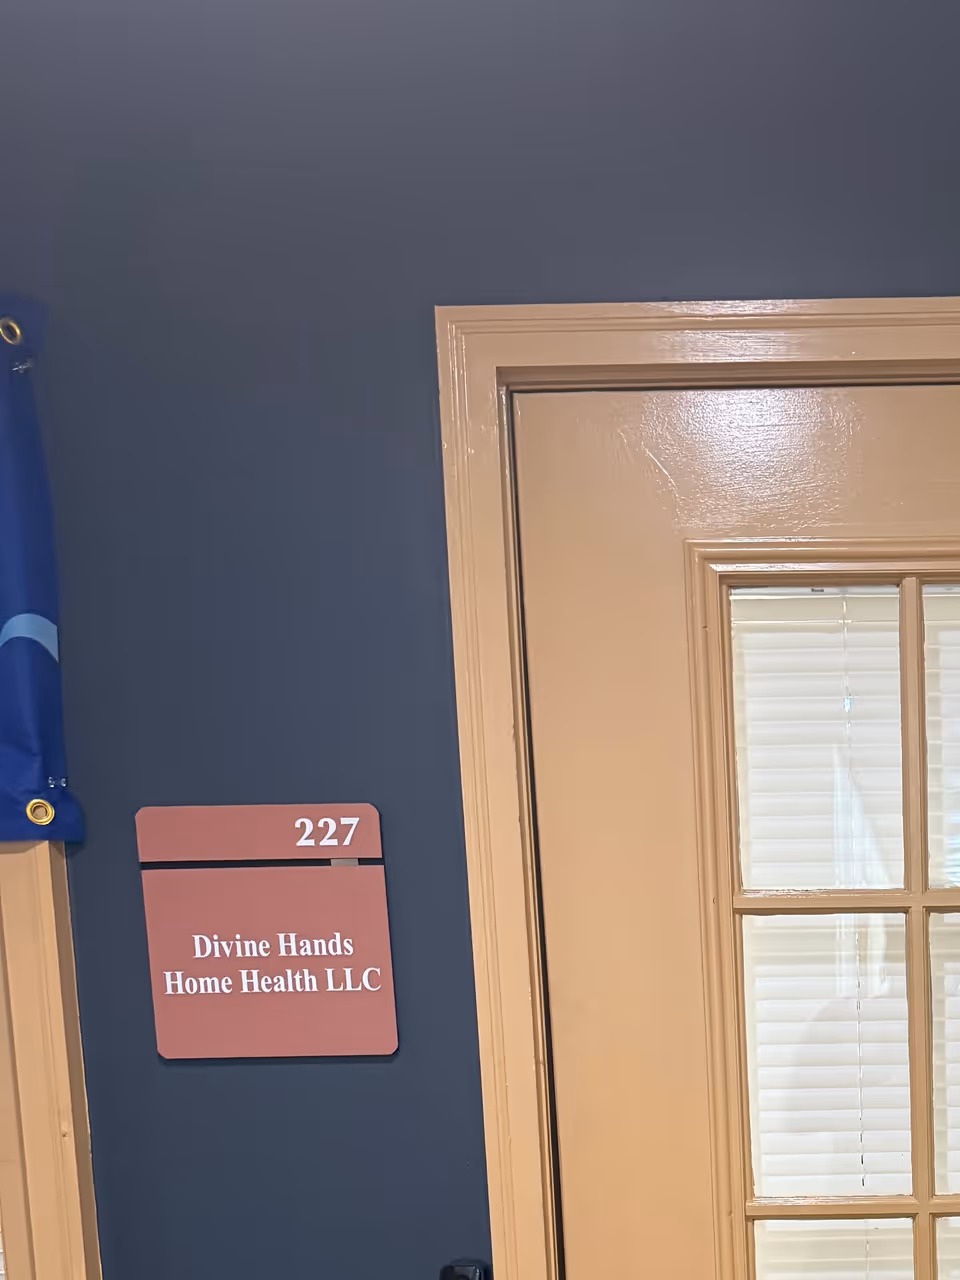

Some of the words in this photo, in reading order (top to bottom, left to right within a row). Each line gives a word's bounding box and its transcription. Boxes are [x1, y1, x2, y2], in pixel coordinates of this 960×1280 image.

[294, 817, 360, 847] 227
[191, 933, 271, 958] Divine
[276, 932, 354, 957] Hands
[163, 971, 233, 995] Home
[238, 968, 319, 993] Health
[324, 967, 382, 992] LLC
